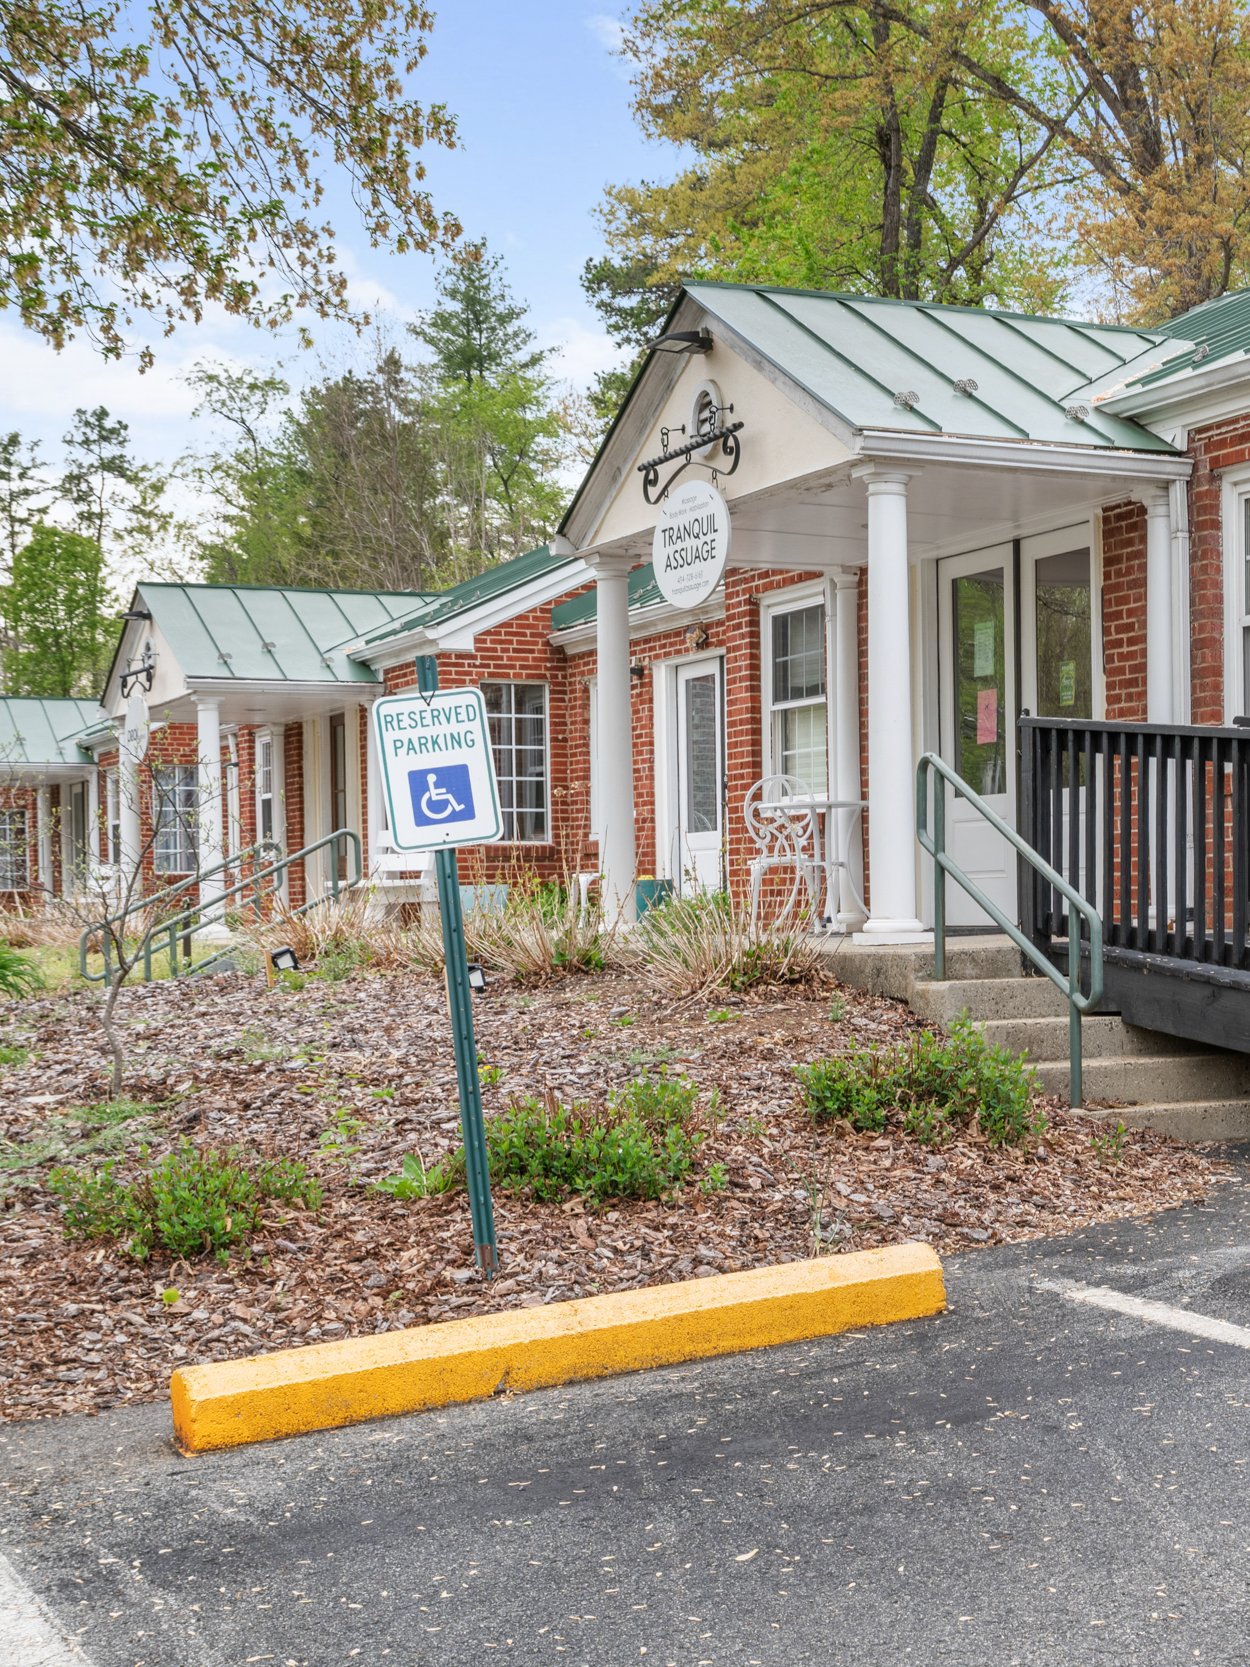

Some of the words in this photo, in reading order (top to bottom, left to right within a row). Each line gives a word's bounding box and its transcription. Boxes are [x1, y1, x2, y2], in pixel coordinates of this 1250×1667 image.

[661, 513, 718, 548] TRANQUIL
[664, 539, 716, 573] ASSUAGE
[383, 703, 477, 732] RESERVED
[393, 730, 476, 757] PARKING
